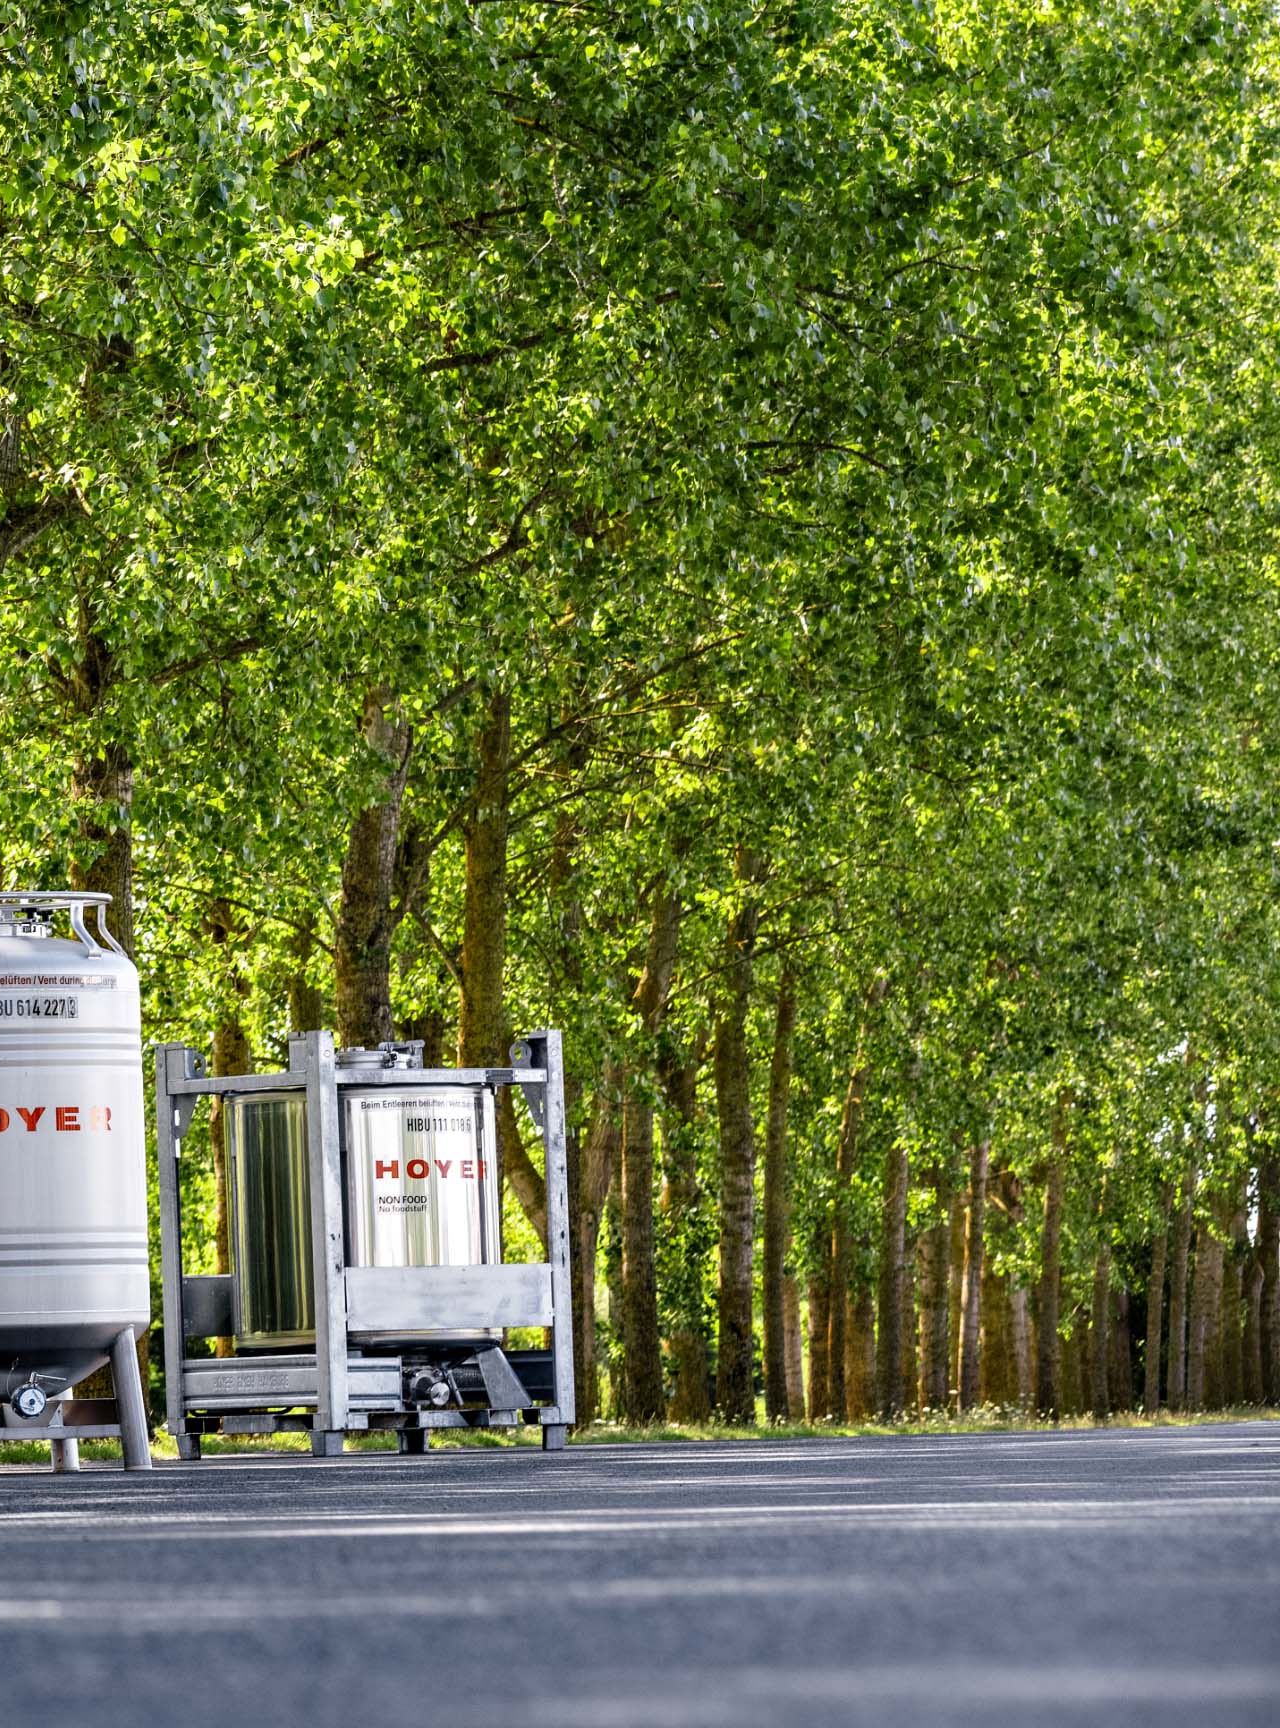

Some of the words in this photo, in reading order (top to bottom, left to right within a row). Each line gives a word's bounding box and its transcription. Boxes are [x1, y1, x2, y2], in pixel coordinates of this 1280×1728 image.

[38, 975, 57, 985] Vent
[17, 999, 41, 1016] 614
[44, 998, 65, 1016] 227
[361, 1101, 380, 1109] Beim
[407, 1118, 431, 1132] HIBU
[433, 1118, 448, 1132] 111
[379, 1196, 400, 1204] NON
[402, 1195, 428, 1204] FOOD
